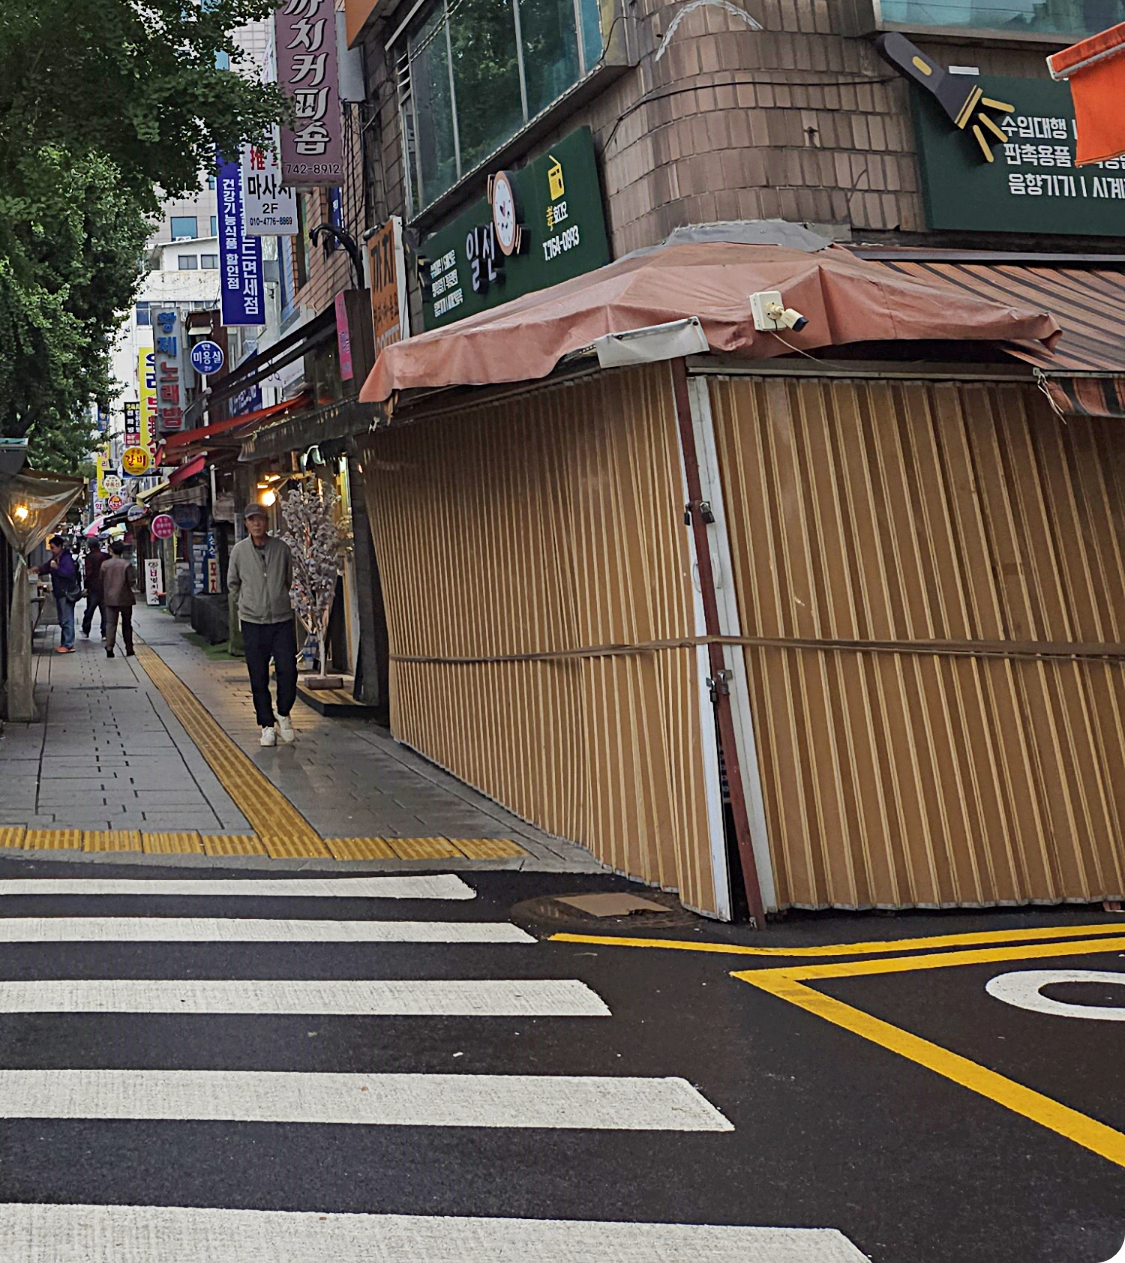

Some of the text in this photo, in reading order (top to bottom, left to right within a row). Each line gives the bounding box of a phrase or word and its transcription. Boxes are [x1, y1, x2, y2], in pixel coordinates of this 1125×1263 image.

[1001, 115, 1068, 139] 수입대행
[1003, 143, 1072, 168] 판촉용품
[285, 163, 341, 175] 742-8912
[1008, 173, 1077, 197] 음향기기
[262, 203, 278, 214] 2F
[226, 254, 240, 290] 할인점
[193, 350, 222, 365] 미용실
[159, 361, 183, 428] 노래방
[125, 454, 146, 466] 갈비
